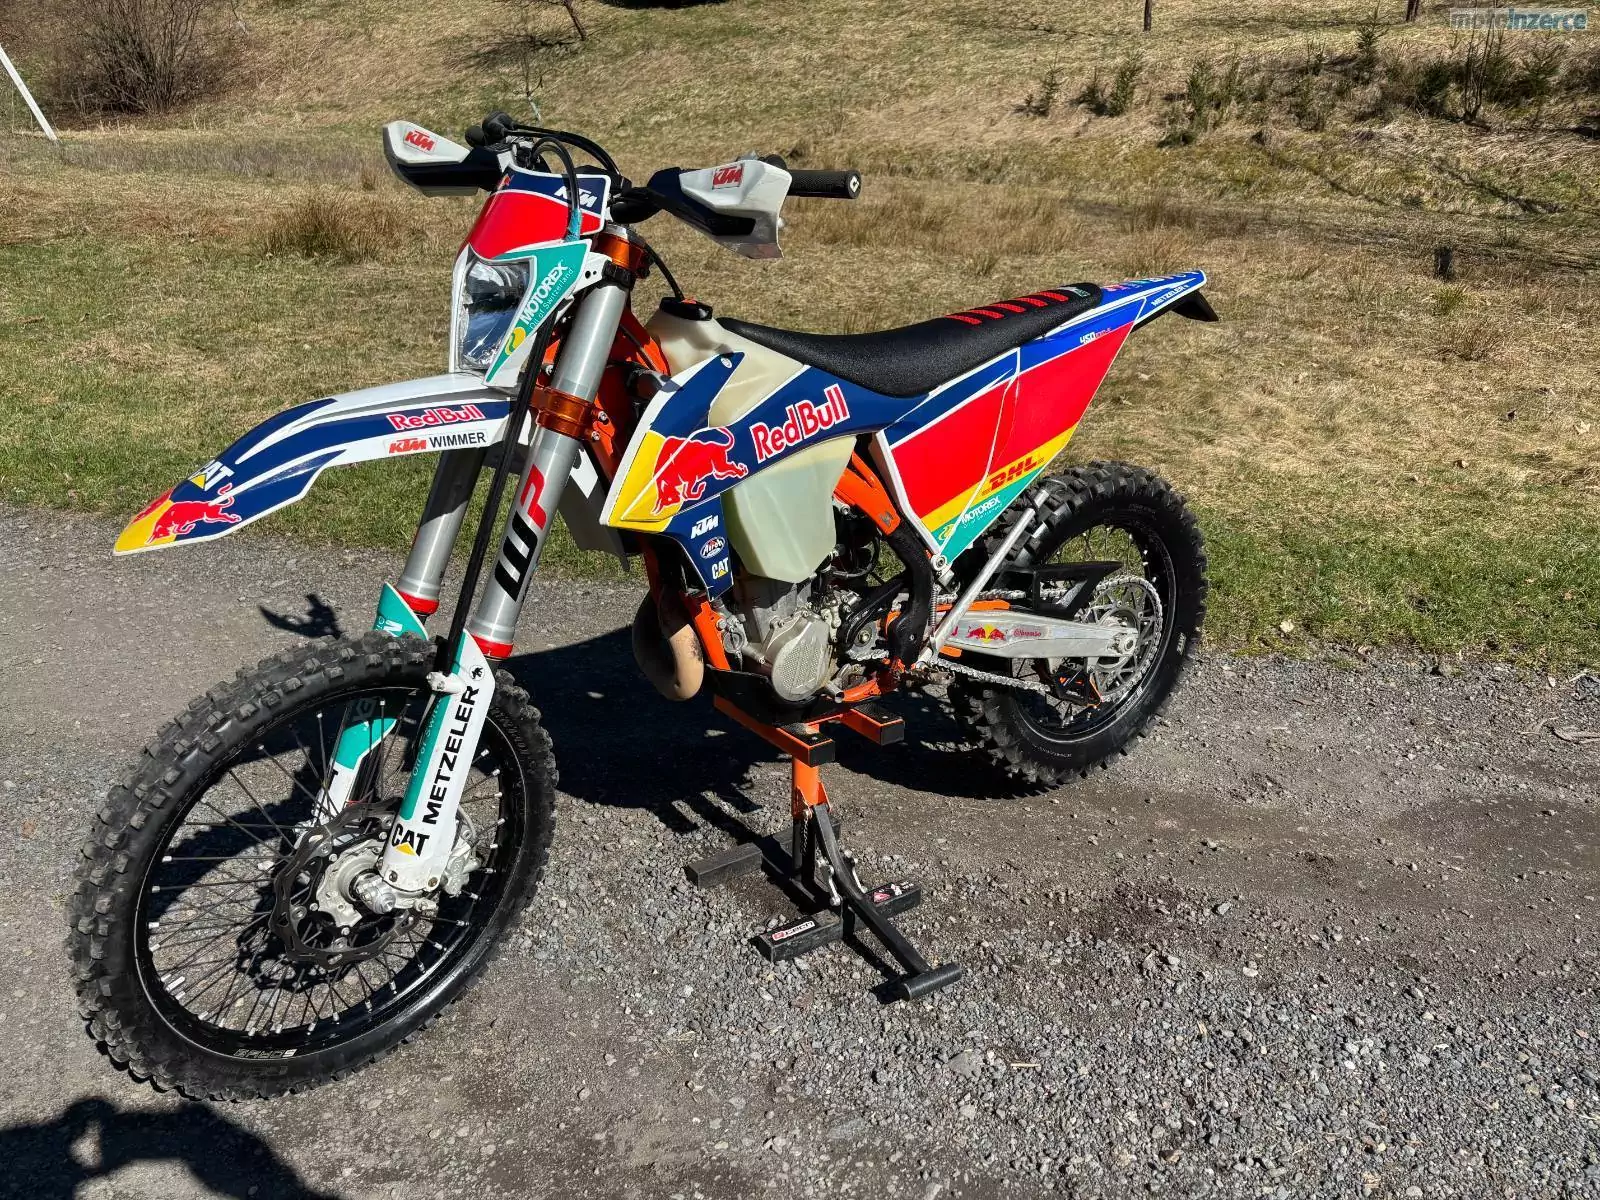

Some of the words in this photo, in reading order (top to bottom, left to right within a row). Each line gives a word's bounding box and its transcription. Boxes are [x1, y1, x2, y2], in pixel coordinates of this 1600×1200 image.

[405, 130, 436, 151] KTM
[713, 165, 742, 185] KTM
[520, 261, 568, 325] MOTOREX
[543, 268, 574, 309] Switzerland
[386, 408, 441, 431] Red
[434, 404, 487, 424] Bull
[749, 404, 802, 464] Red
[794, 383, 850, 439] Bull
[389, 438, 427, 454] KTM
[429, 432, 487, 448] WIMMER
[990, 456, 1038, 491] DHL
[960, 496, 1001, 525] MOTOREX
[494, 463, 547, 602] WP
[690, 515, 719, 539] KTM
[711, 557, 728, 580] CAT
[422, 685, 480, 825] METZELER
[391, 823, 430, 856] CAT
